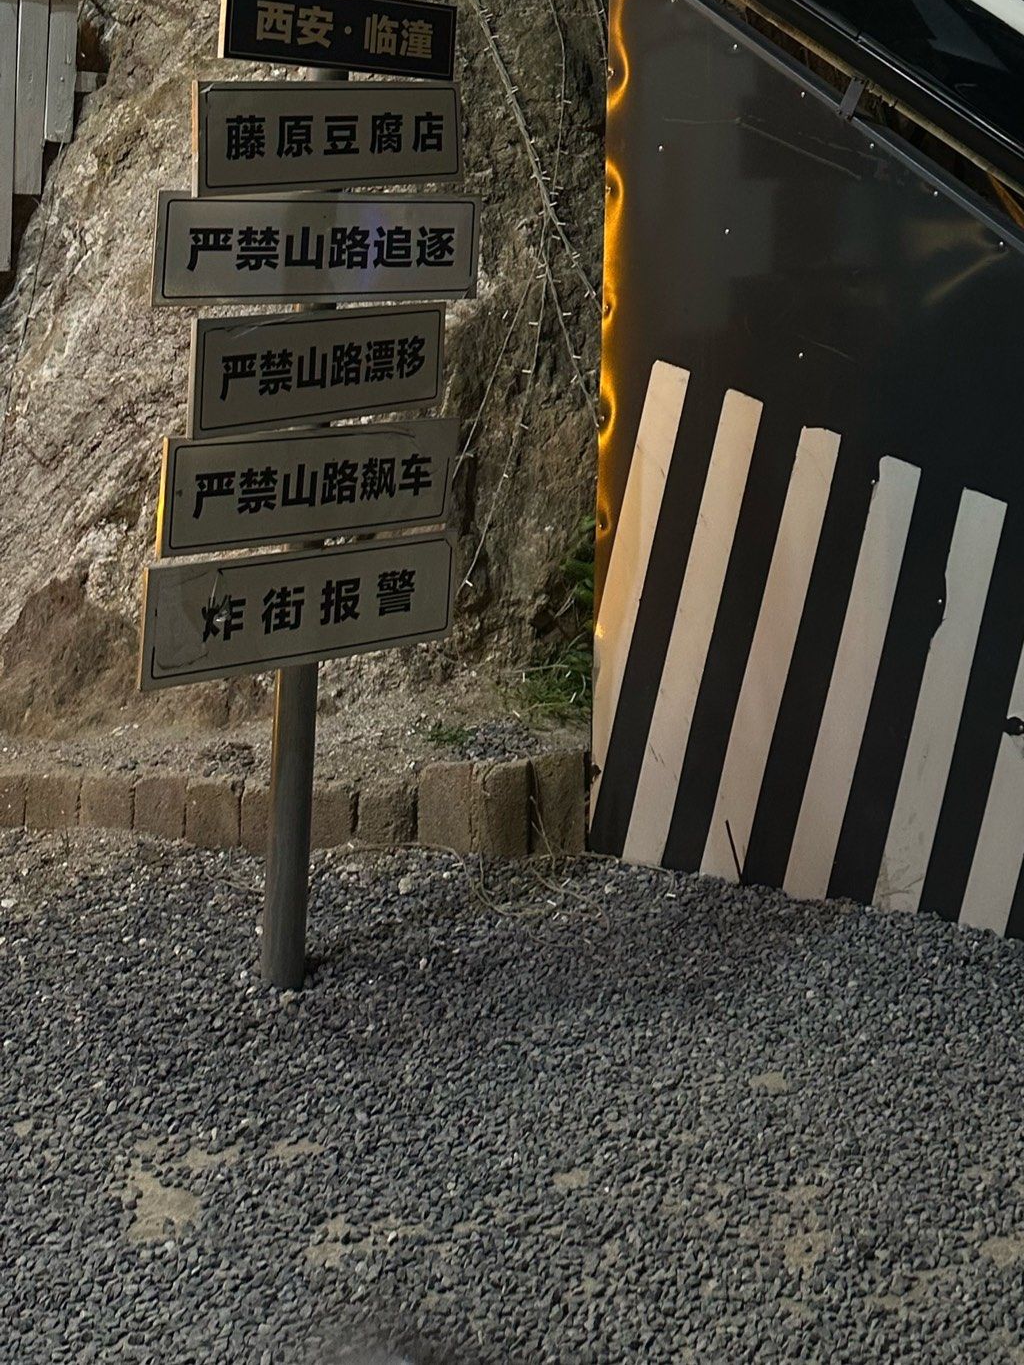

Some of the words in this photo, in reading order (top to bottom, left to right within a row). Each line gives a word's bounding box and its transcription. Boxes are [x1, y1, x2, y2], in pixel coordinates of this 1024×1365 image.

[225, 111, 444, 161] 藤原豆腐店
[186, 225, 456, 272] 严禁山路追逐
[219, 335, 427, 402] 严禁山路漂移
[192, 453, 433, 520] 严禁山路飙车
[201, 568, 417, 643] 炸街报警
